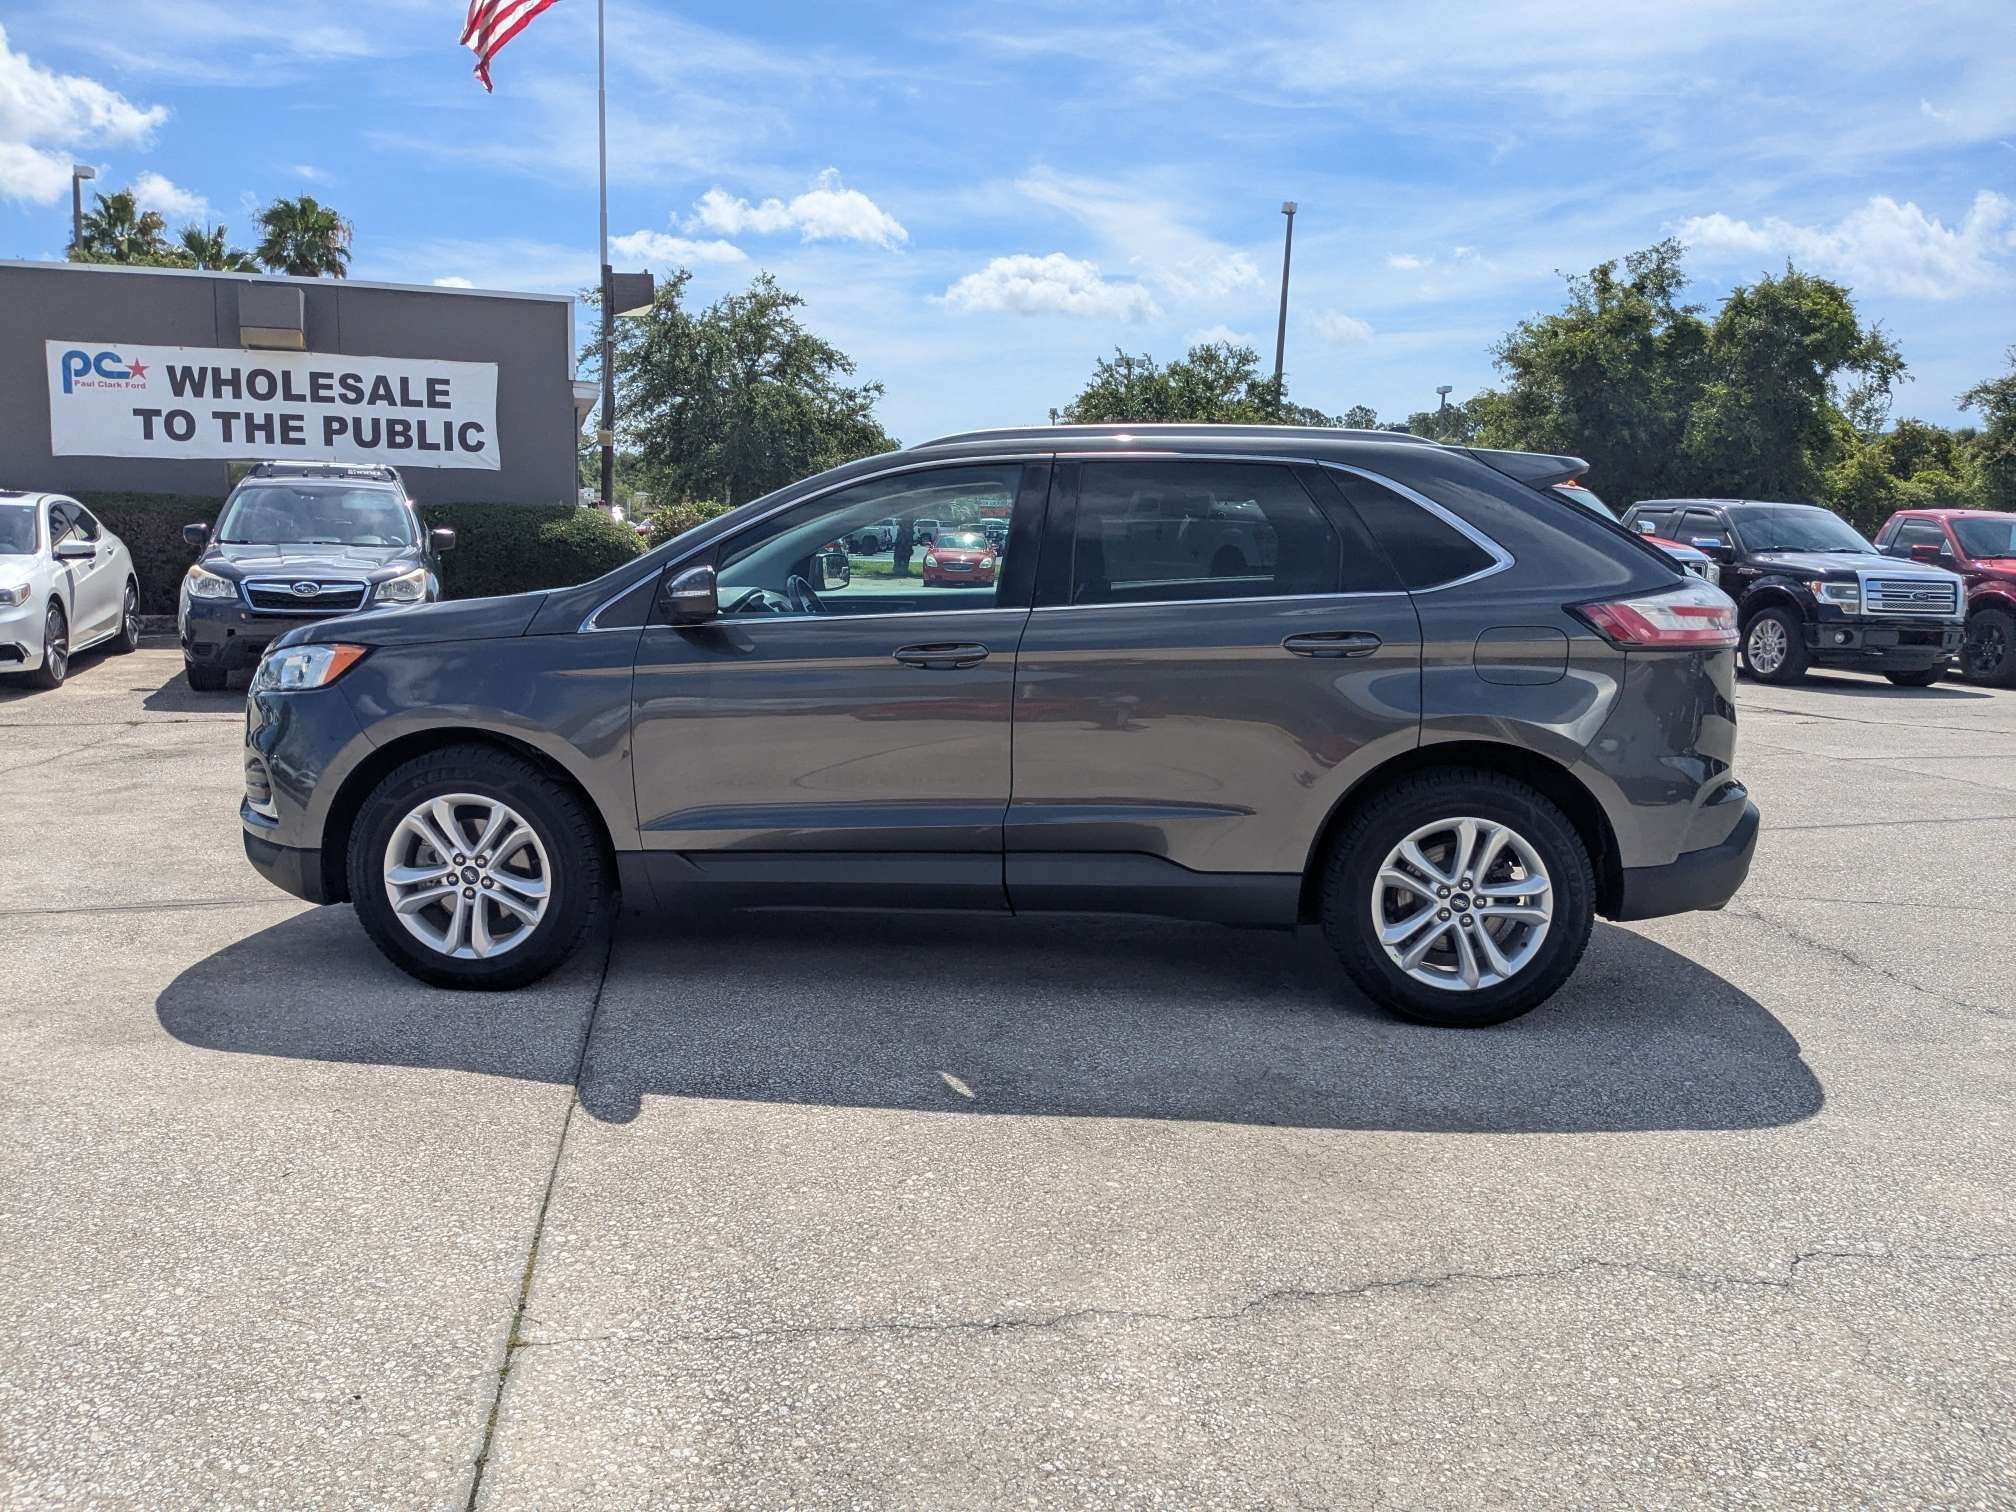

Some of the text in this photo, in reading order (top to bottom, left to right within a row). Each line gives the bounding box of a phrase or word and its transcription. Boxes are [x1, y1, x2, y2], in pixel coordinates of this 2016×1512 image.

[74, 379, 147, 390] Paul Clark Ford
[165, 364, 452, 410] WHOLESALE
[132, 407, 486, 453] TO THE PUBLIC
